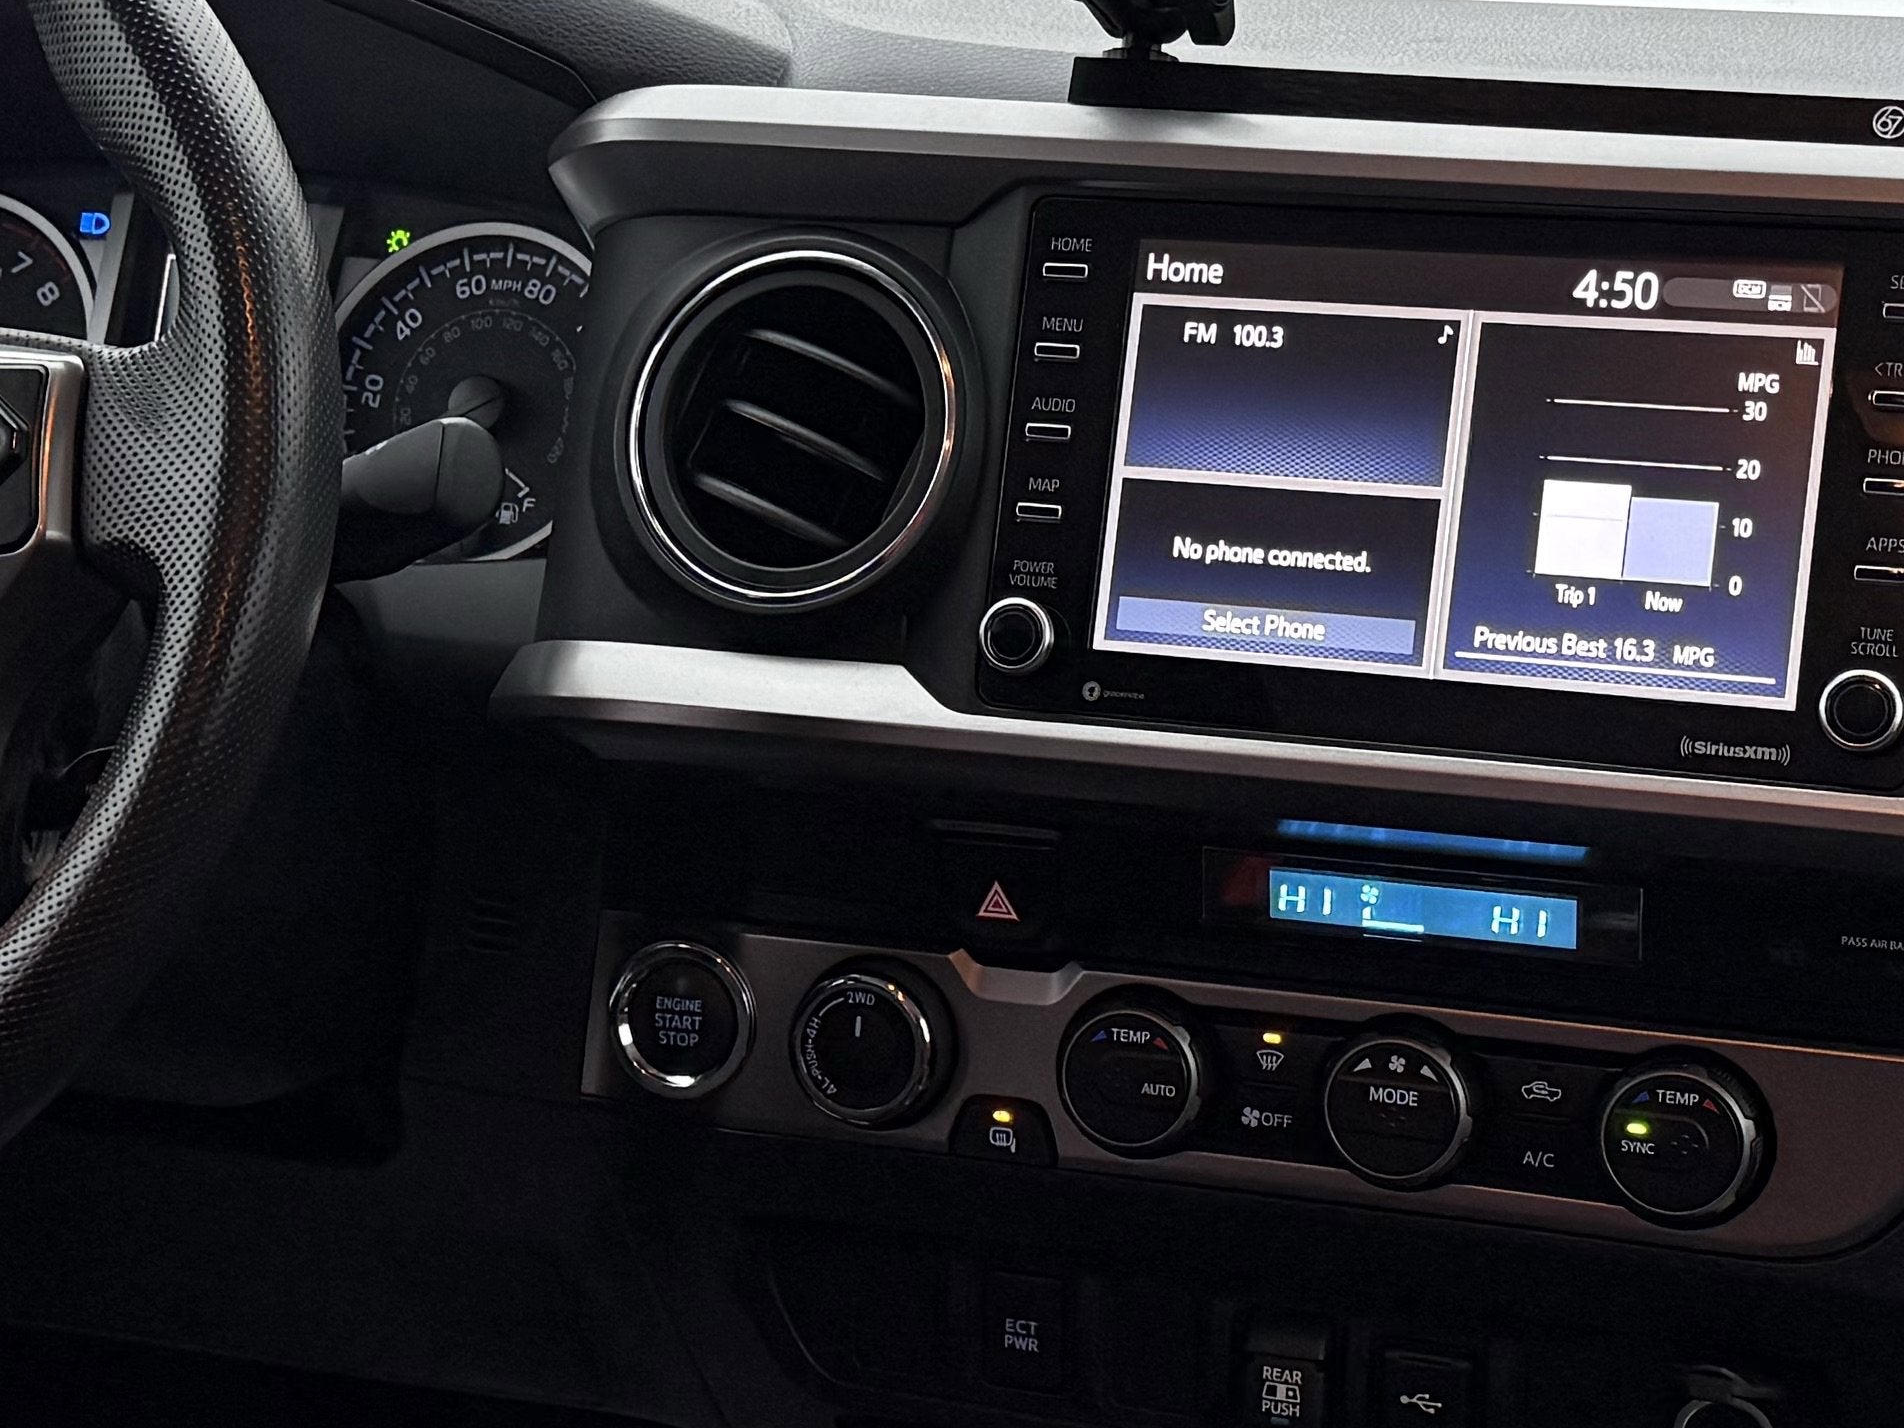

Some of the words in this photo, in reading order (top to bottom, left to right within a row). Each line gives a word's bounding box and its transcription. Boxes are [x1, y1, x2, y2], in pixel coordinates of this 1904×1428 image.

[1875, 107, 1904, 137] 67
[1050, 237, 1093, 253] HOME
[11, 251, 34, 274] 7
[1146, 252, 1225, 285] Home
[36, 281, 61, 307] 8
[455, 274, 487, 300] 60
[489, 278, 524, 294] MPH
[523, 278, 558, 306] 80
[1572, 269, 1660, 312] 4:50
[395, 308, 423, 341] 40
[470, 315, 494, 332] 100
[1041, 316, 1084, 333] MENU
[1182, 322, 1217, 346] FM
[1233, 324, 1285, 349] 100.3
[361, 374, 385, 410] 20
[1737, 372, 1781, 395] MPG
[1031, 396, 1077, 414] AUDIO
[1742, 400, 1768, 422] 30
[1736, 459, 1762, 481] 20
[1028, 477, 1061, 494] MAP
[521, 496, 537, 513] F
[1731, 517, 1754, 539] 10
[1172, 535, 1203, 560] No
[1205, 539, 1265, 566] phone
[1267, 549, 1372, 574] connected.
[1013, 559, 1056, 575] POWER
[1008, 574, 1059, 590] VOLUME
[1728, 575, 1744, 597] 0
[1555, 584, 1585, 609] Trip
[1587, 585, 1597, 607] 1
[1644, 590, 1684, 614] Now
[1201, 609, 1262, 636] Select
[1263, 613, 1327, 642] Phone
[1859, 626, 1895, 643] TUNE
[1473, 625, 1559, 657] Previous
[1560, 632, 1608, 660] Best
[1613, 637, 1656, 664] 16.3
[1672, 643, 1717, 669] MPG
[1850, 640, 1900, 659] SCROLL
[1840, 935, 1868, 948] PASS
[1870, 938, 1888, 950] AIR
[655, 995, 703, 1013] ENGINE
[846, 991, 876, 1006] 2WD
[654, 1012, 703, 1031] START
[658, 1030, 700, 1047] STOP
[1111, 1027, 1151, 1045] TEMP
[1140, 1082, 1176, 1098] AUTO
[1368, 1085, 1420, 1107] MODE
[1655, 1089, 1700, 1107] TEMP
[1260, 1111, 1294, 1128] OFF
[1620, 1139, 1656, 1155] SYNC
[1522, 1150, 1556, 1169] A/C
[1005, 1317, 1039, 1336] ECT
[1004, 1333, 1040, 1353] PWR
[1262, 1365, 1303, 1385] REAR
[1261, 1399, 1301, 1418] PUSH
